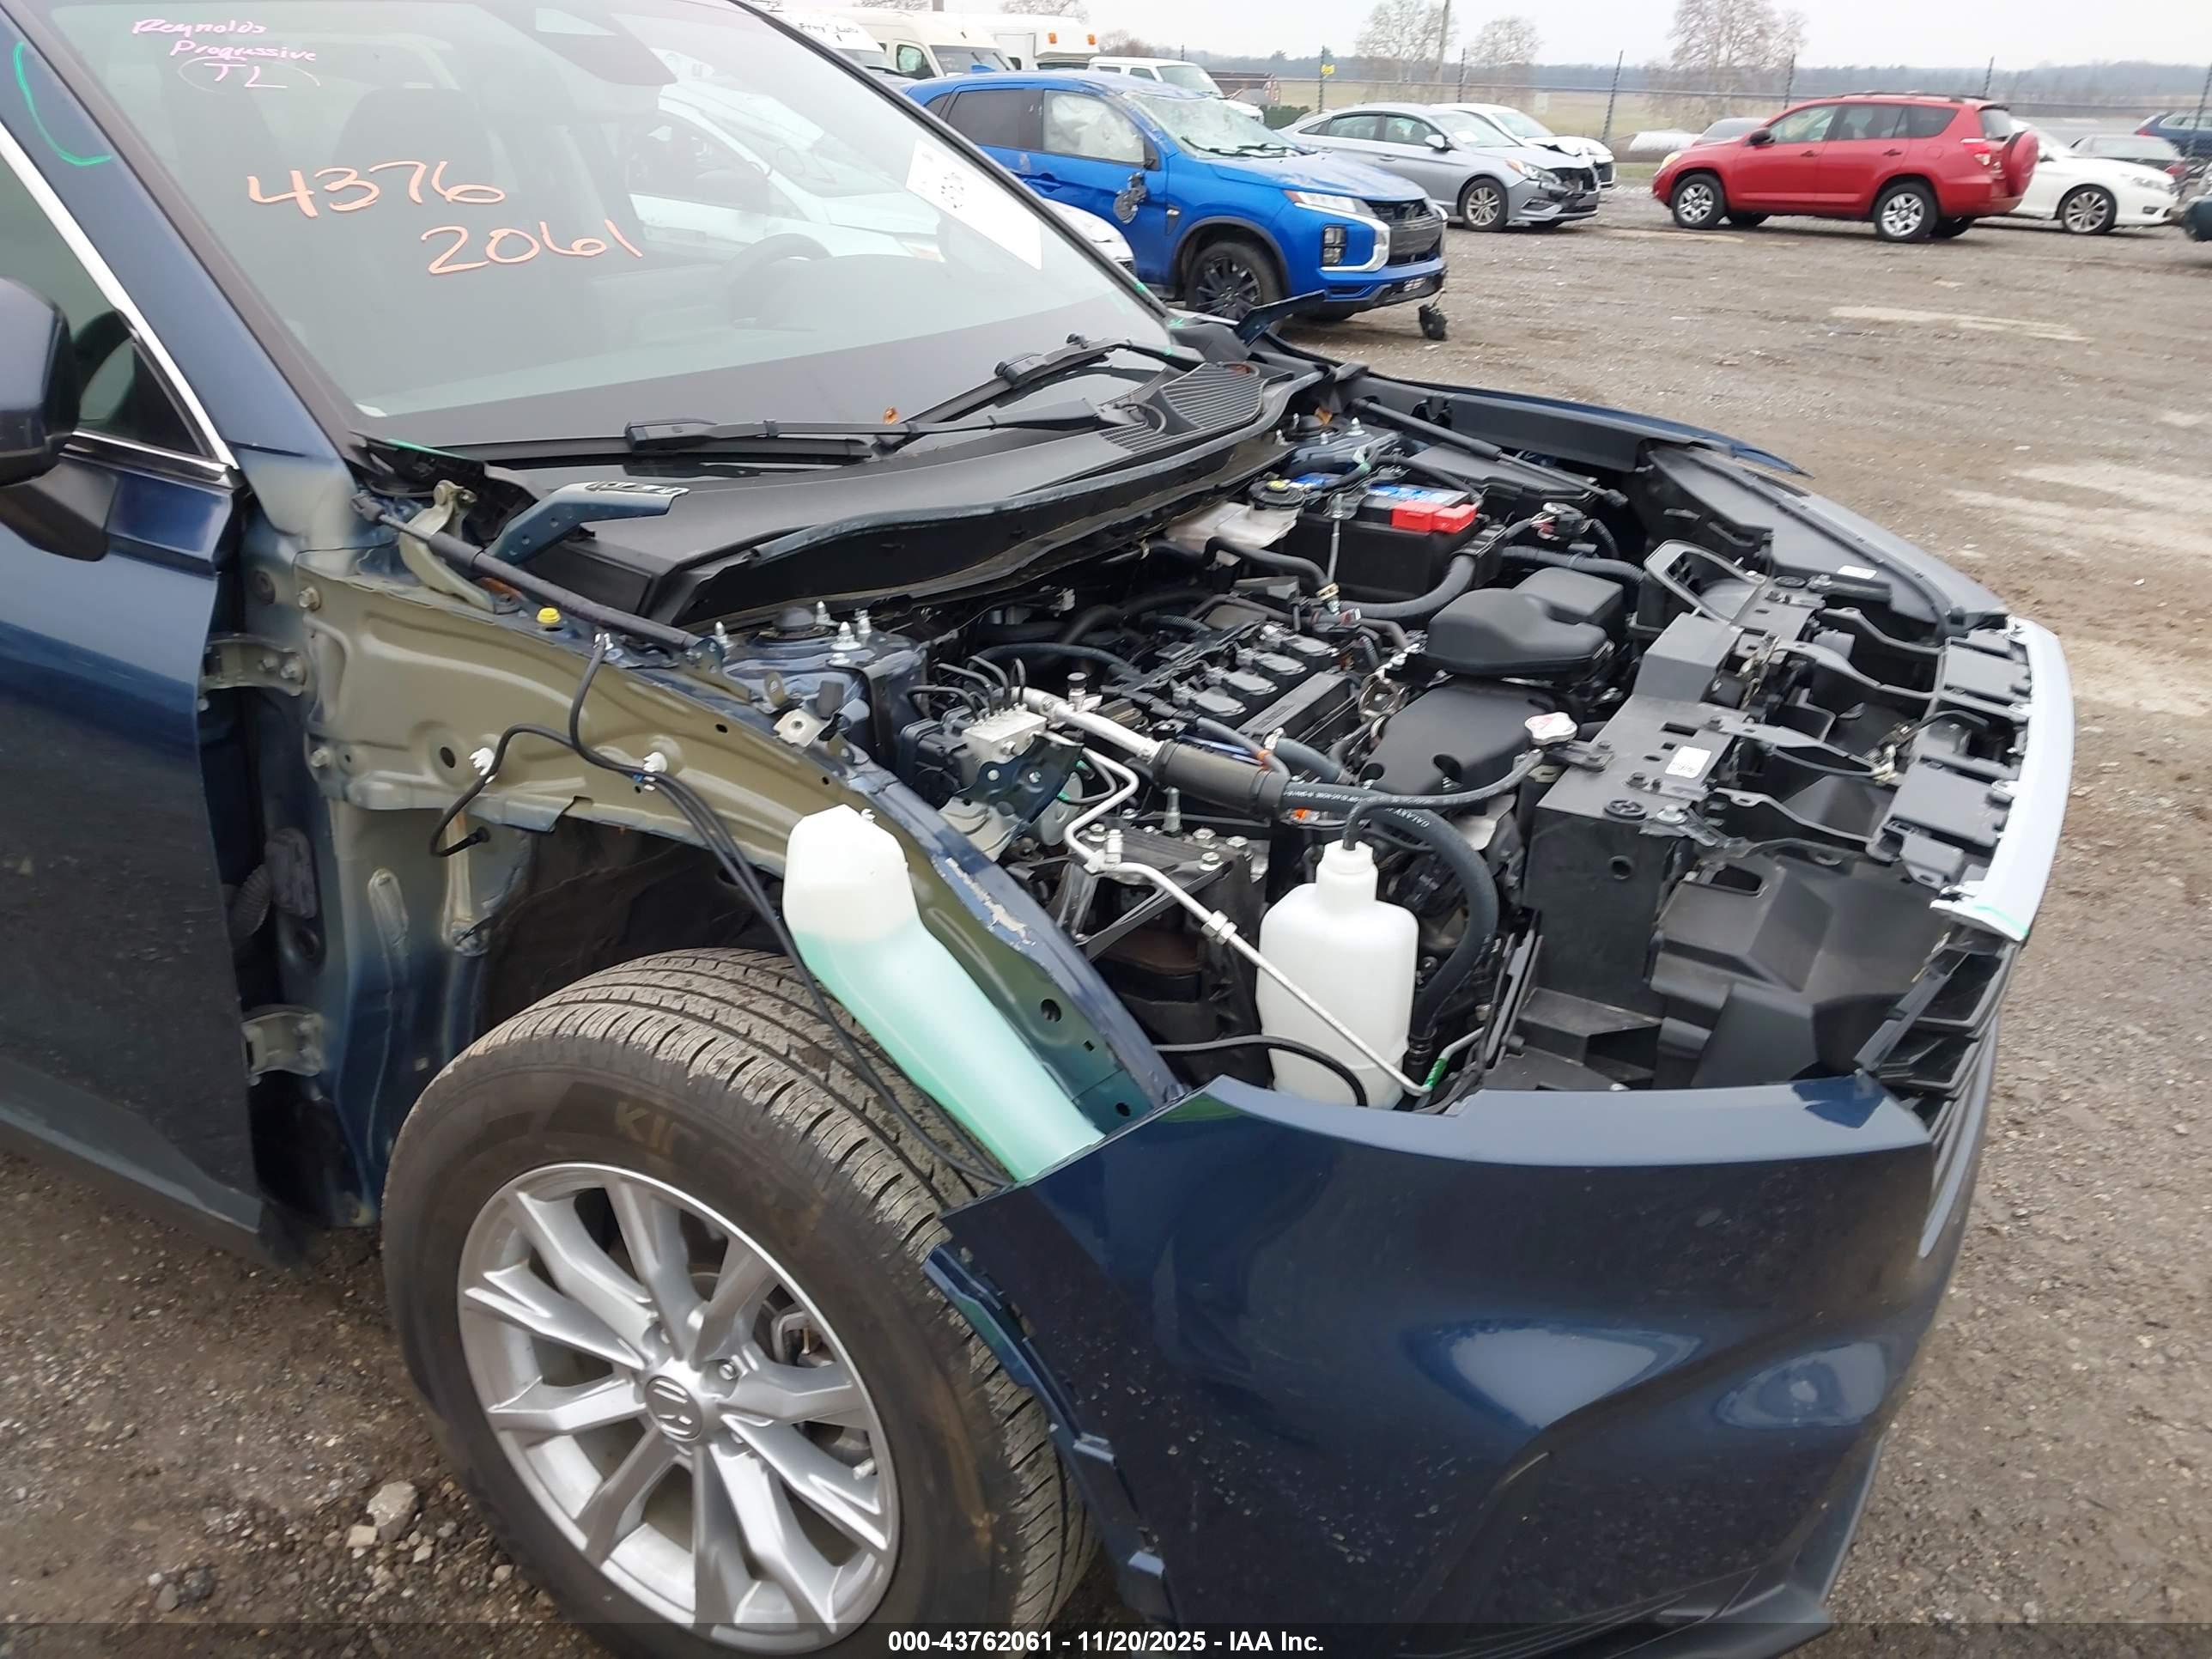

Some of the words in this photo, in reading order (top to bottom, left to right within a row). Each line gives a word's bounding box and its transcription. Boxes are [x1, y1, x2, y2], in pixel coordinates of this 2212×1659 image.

[131, 19, 267, 37] Reynolds
[169, 40, 317, 60] Progressive
[247, 161, 506, 217] 4376
[421, 219, 642, 275] 2061
